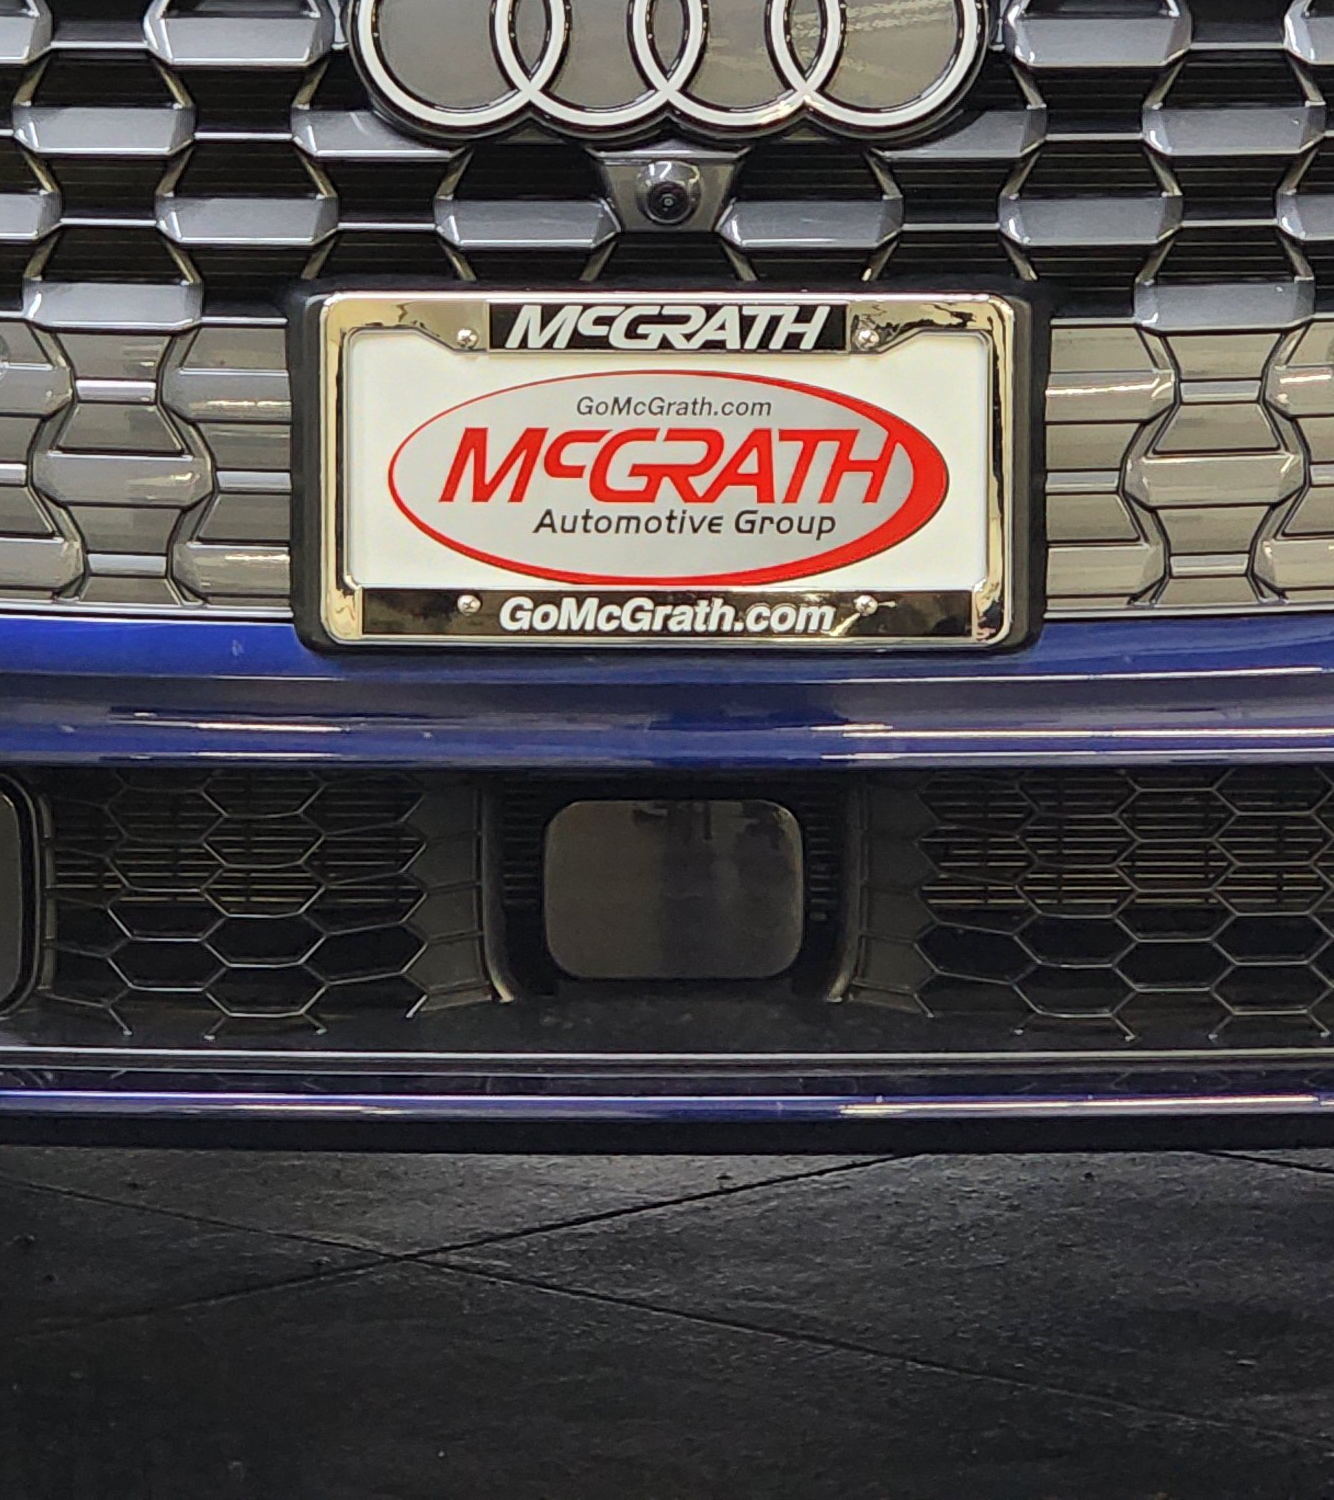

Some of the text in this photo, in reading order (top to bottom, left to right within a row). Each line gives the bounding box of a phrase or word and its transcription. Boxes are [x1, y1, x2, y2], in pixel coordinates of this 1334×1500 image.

[576, 396, 772, 417] GoMcGrath.com
[533, 508, 837, 540] Automotive Group
[499, 596, 835, 633] GoMcGrath.com
